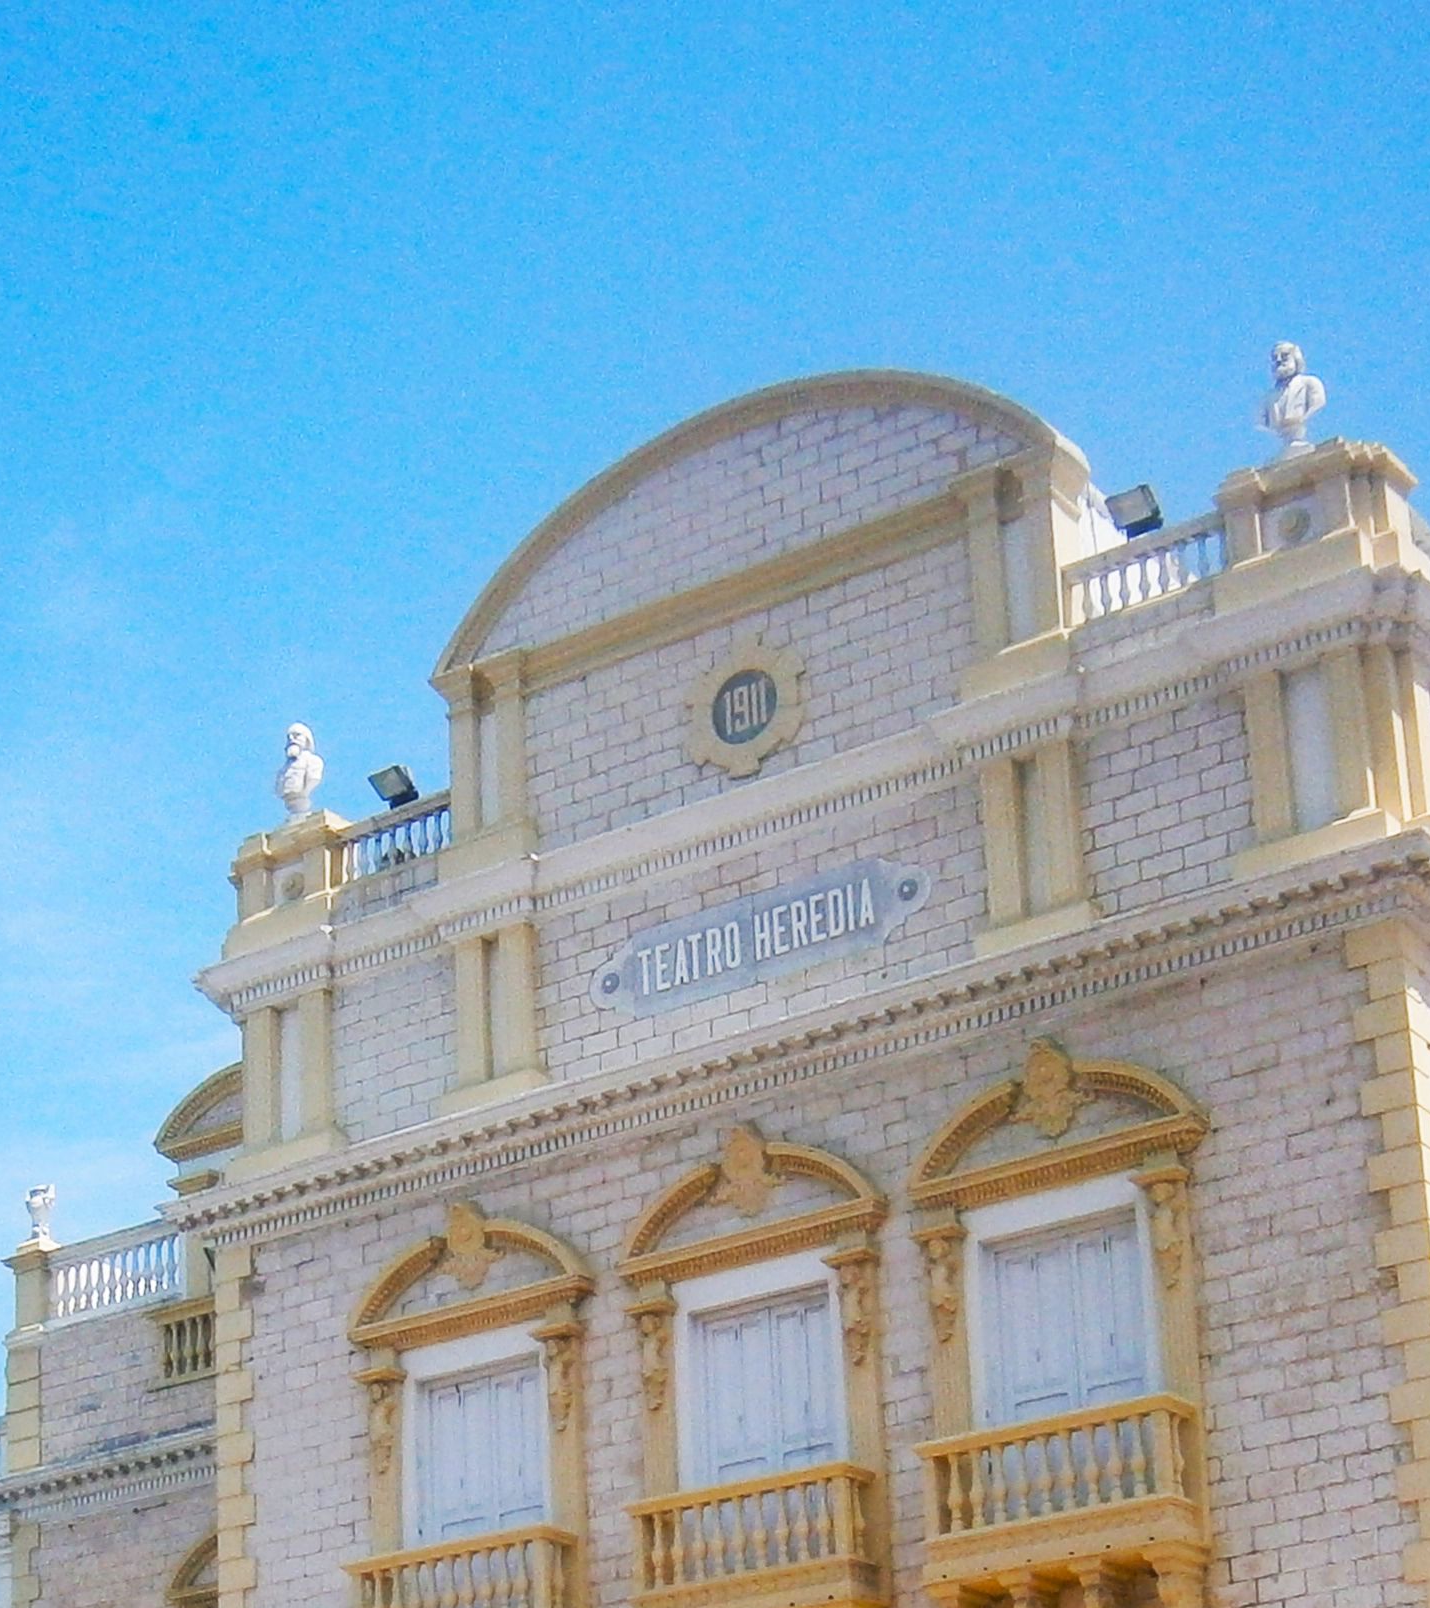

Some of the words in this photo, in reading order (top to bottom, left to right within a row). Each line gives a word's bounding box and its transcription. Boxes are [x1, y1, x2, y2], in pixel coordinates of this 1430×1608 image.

[724, 677, 766, 735] 1911
[637, 921, 743, 996] TEATRO
[753, 879, 876, 962] HEREDIA
